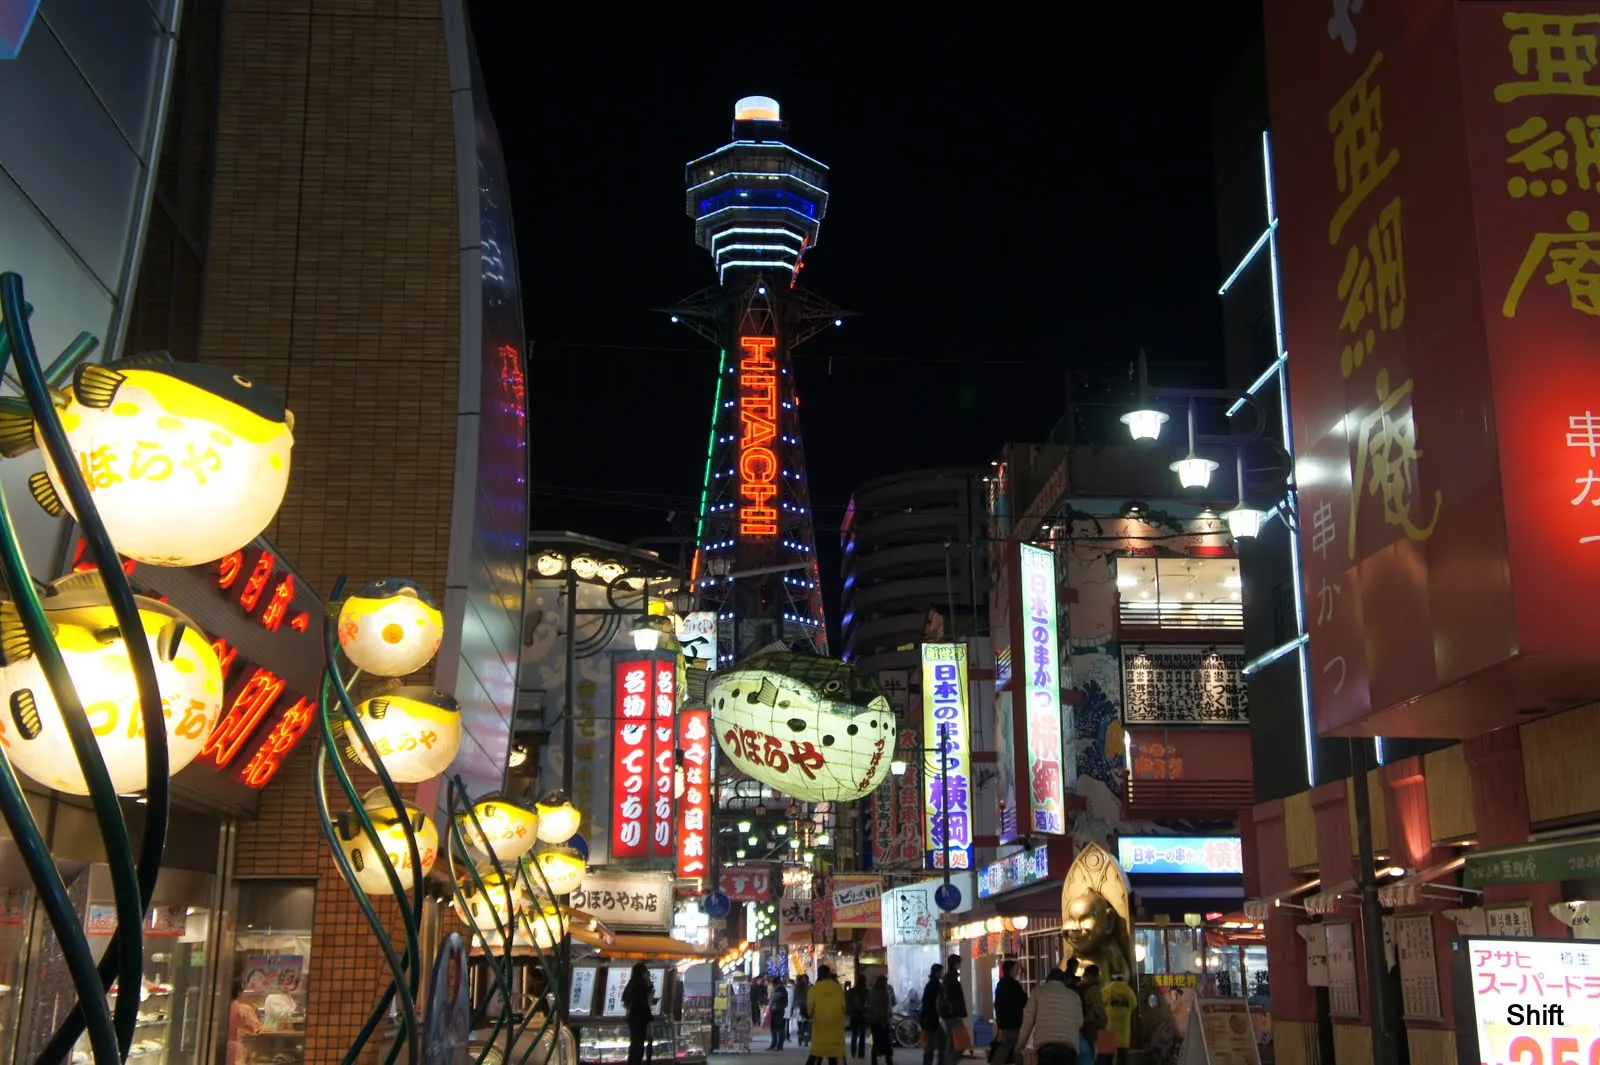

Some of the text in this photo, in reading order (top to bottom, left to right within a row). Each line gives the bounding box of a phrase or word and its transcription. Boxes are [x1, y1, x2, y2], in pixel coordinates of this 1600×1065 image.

[741, 336, 777, 535] HITACHI
[59, 440, 222, 492] ぼらや
[1566, 411, 1600, 543] 串か
[1313, 500, 1345, 694] 串かつ
[723, 724, 824, 780] づぼらや
[571, 889, 658, 912] づぼらや本店
[1474, 950, 1590, 968] アサヒ 樽生
